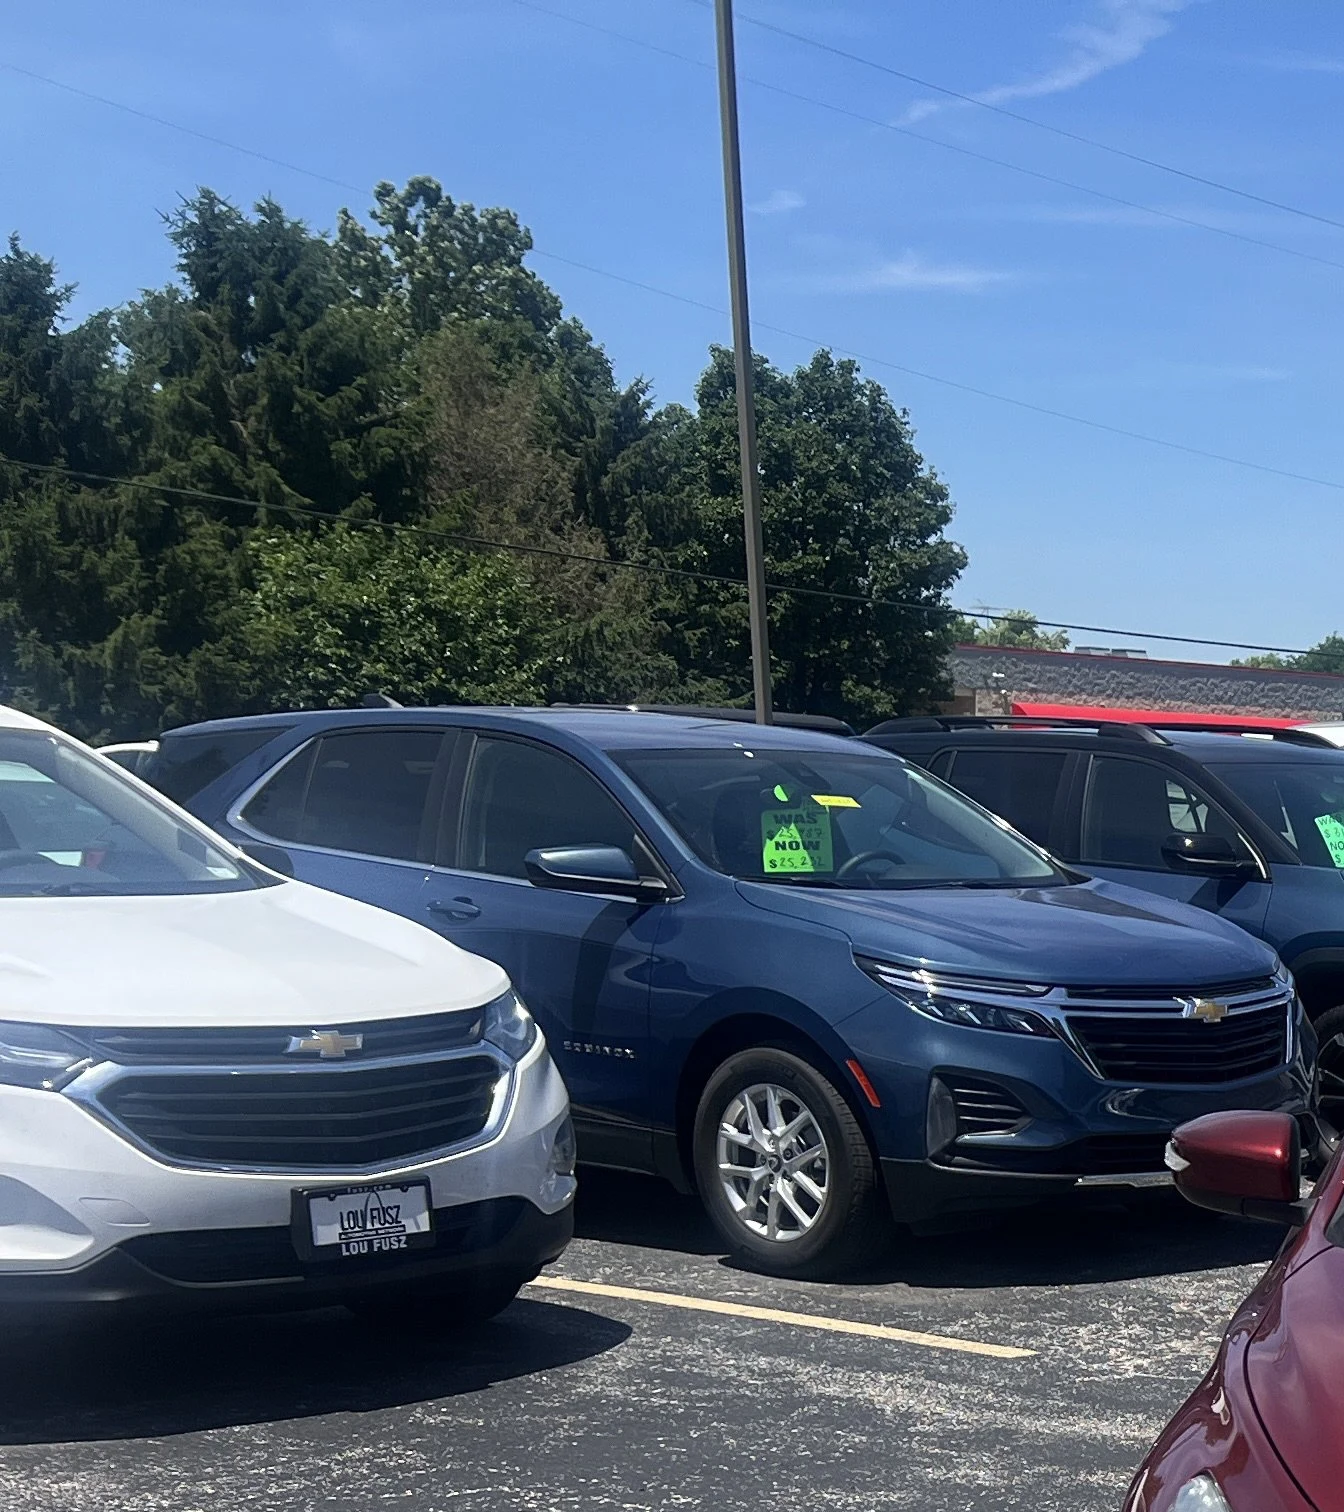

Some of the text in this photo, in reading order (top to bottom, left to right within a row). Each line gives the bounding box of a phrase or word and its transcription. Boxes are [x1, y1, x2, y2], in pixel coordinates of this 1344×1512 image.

[773, 814, 818, 825] WAS
[774, 841, 820, 851] NOW
[339, 1205, 402, 1231] LOU FUSZ
[341, 1236, 408, 1256] LOU FUSZ
